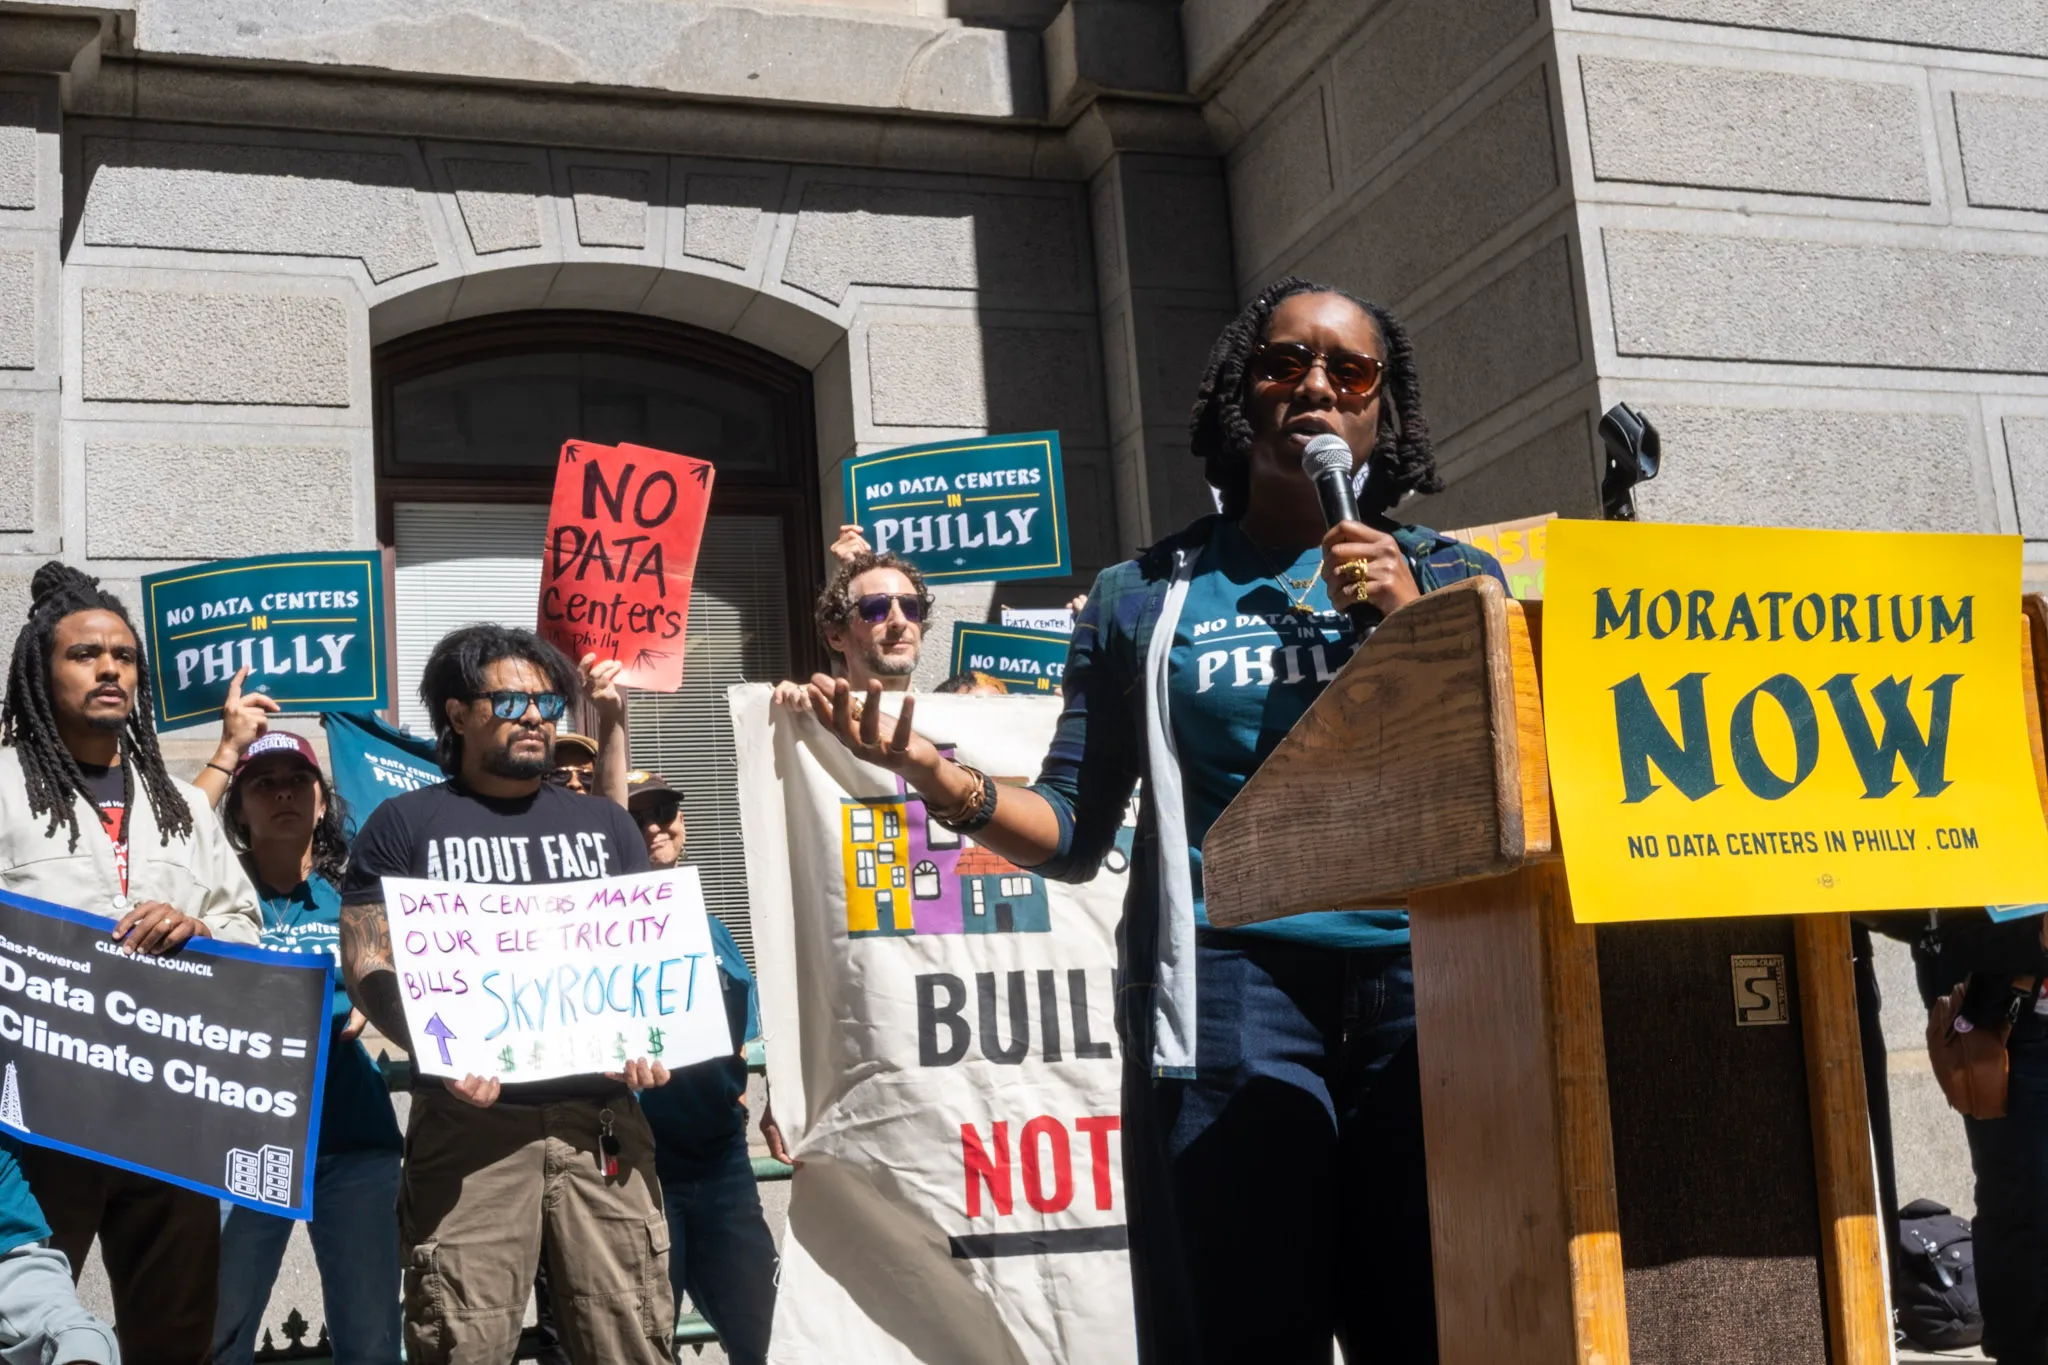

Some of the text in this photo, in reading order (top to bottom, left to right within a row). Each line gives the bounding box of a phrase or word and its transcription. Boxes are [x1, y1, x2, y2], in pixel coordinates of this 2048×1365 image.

[582, 459, 677, 528] NO
[866, 468, 1041, 500] NO DATA CENTERS
[947, 494, 962, 507] IN
[873, 507, 1039, 556] PHILLY
[552, 525, 666, 599] DATA
[166, 591, 359, 627] NO DATA CENTERS
[251, 616, 267, 630] IN
[543, 586, 681, 639] Centers
[1194, 618, 1227, 637] NO
[1236, 613, 1295, 629] DATA
[1592, 587, 1976, 644] MORATORIUM
[1298, 627, 1315, 638] IN
[175, 634, 356, 691] PHILLY
[970, 655, 994, 670] NO
[1000, 656, 1041, 675] DATA
[1037, 677, 1049, 690] IN
[1196, 642, 1360, 694] PHIL
[1607, 672, 1966, 804] NOW
[364, 752, 378, 763] NO
[380, 757, 406, 771] DATA
[427, 832, 611, 883] ABOUT FACE
[1627, 834, 1659, 859] NO
[1666, 833, 1720, 857] DATA
[1726, 830, 1818, 856] CENTERS
[1825, 830, 1847, 853] IN
[1852, 828, 1916, 851] PHILLY
[399, 892, 468, 916] DATA
[586, 882, 673, 911] MAKE
[286, 936, 297, 945] IN
[405, 914, 671, 957] OUR ELETRICITY
[157, 957, 214, 977] COUNCIL
[0, 955, 95, 1015] Data
[105, 990, 272, 1059] Centers
[404, 969, 469, 1001] BILLS
[481, 951, 707, 1041] SKYROCKET
[915, 968, 1118, 1067] BUIL
[0, 1004, 297, 1118] Climate Chaos
[960, 1114, 1121, 1218] NOT
